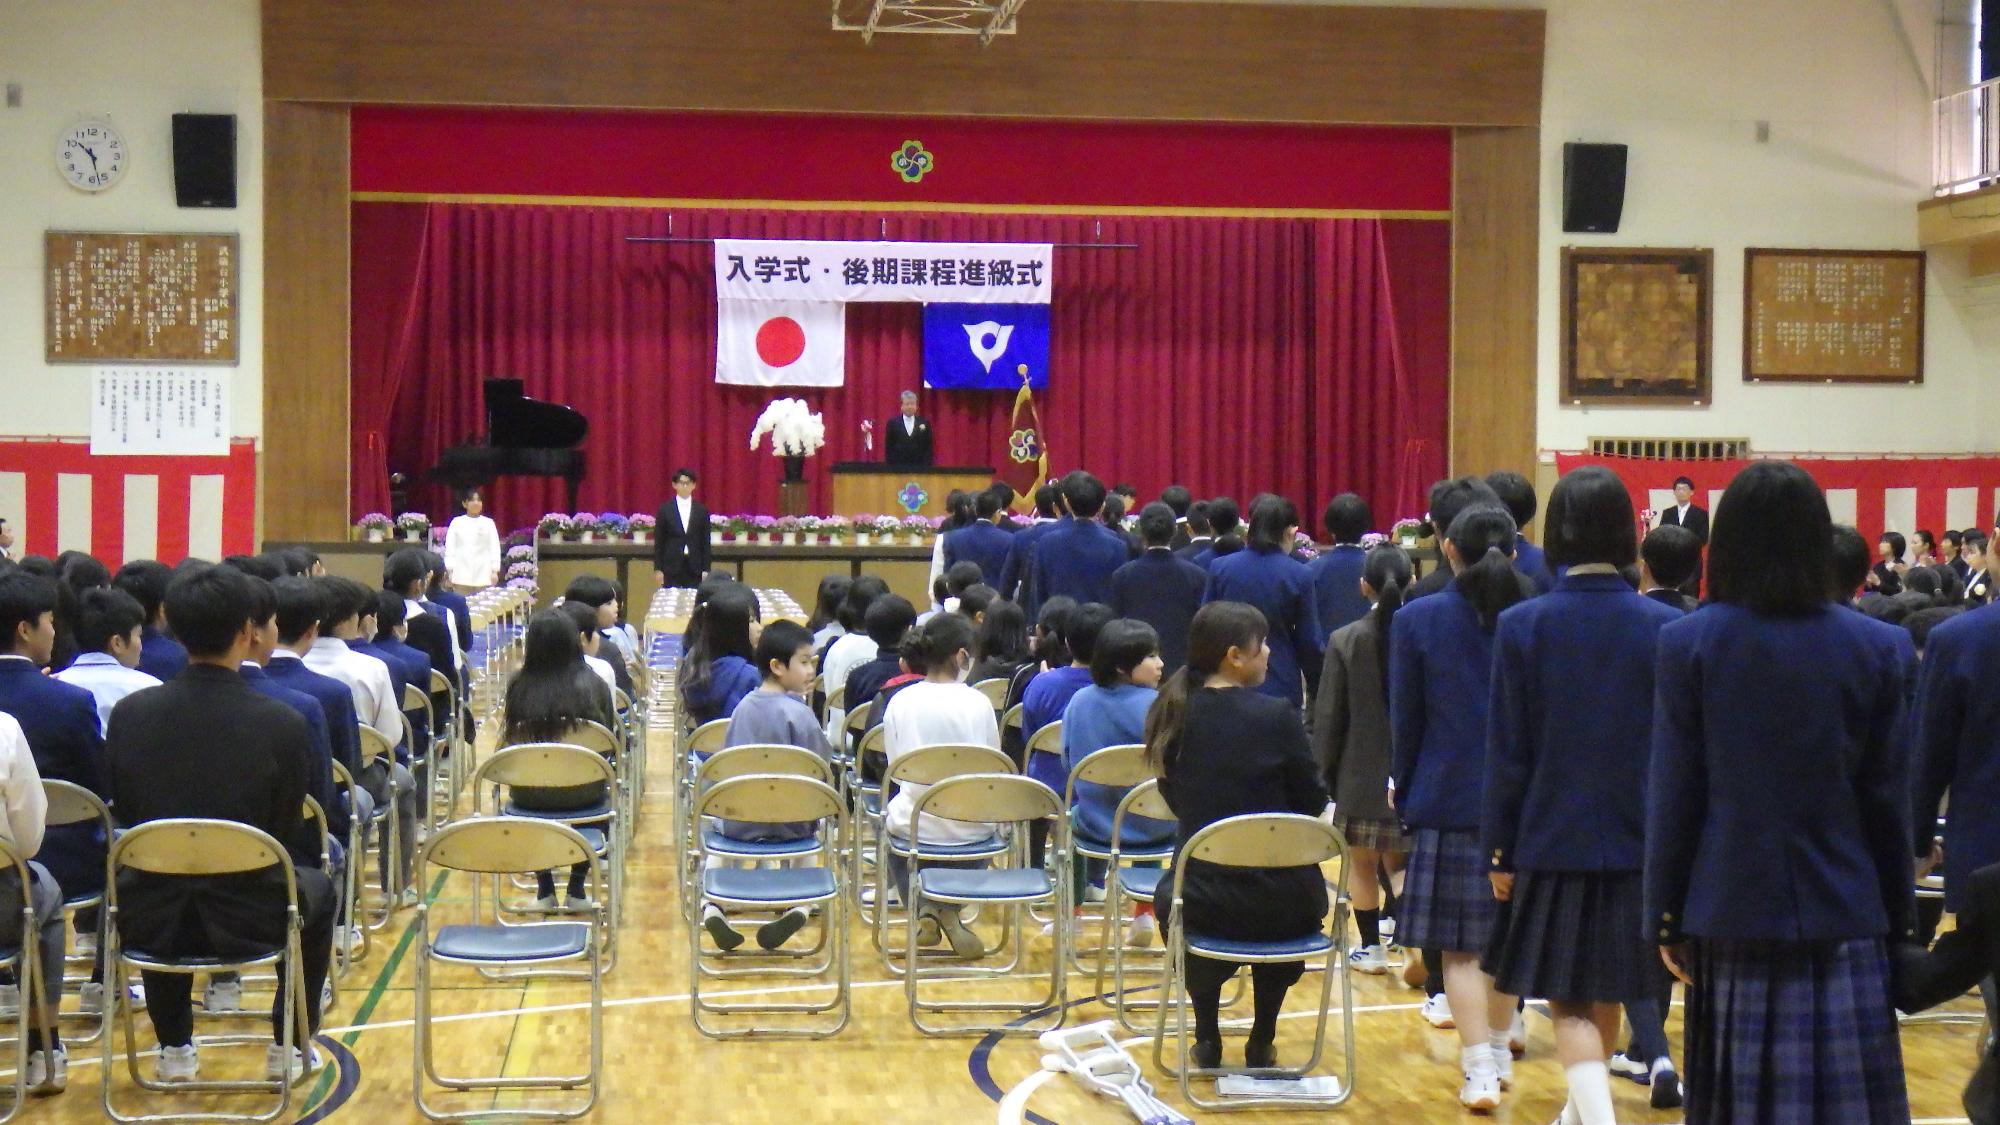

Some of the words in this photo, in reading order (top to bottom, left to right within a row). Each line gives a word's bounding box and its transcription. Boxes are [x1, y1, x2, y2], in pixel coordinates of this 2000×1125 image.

[76, 130, 85, 139] 11
[88, 128, 98, 136] 12
[110, 141, 118, 149] 2
[64, 151, 71, 160] 9
[114, 152, 120, 160] 3
[111, 164, 117, 172] 4
[89, 175, 96, 183] 6
[101, 173, 108, 181] 5
[726, 254, 1044, 288] 入学式・後期課程進級式
